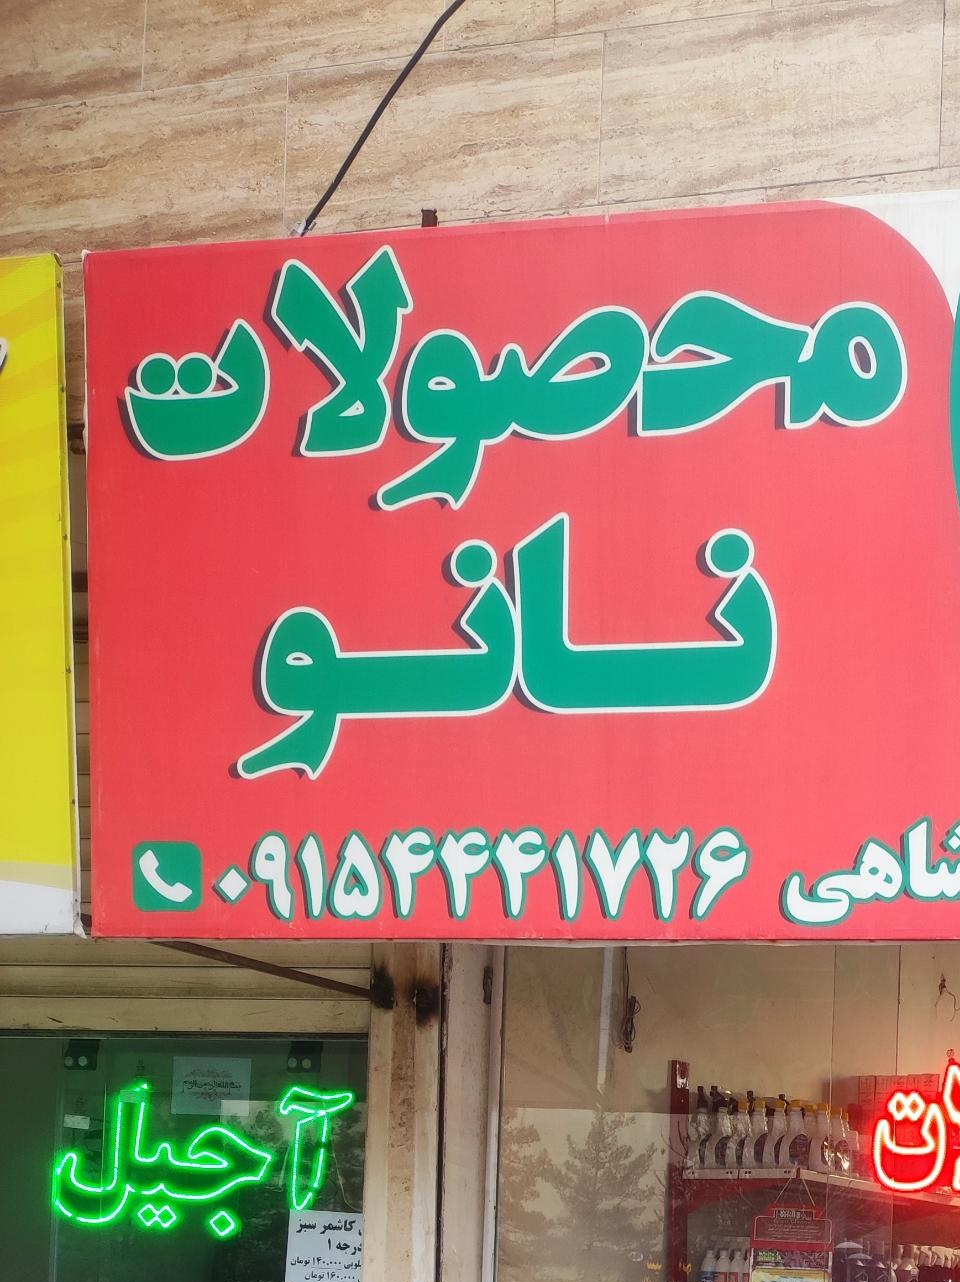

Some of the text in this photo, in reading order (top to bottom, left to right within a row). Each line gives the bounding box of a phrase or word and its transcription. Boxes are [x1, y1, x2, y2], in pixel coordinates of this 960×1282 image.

[123, 245, 909, 510] محصولات
[237, 513, 778, 779] نانو
[214, 828, 749, 921] ۰۹۱۵۴۴۴۱۷۲۶
[52, 1083, 353, 1237] آجیل
[290, 1256, 311, 1267] تومان
[296, 1219, 356, 1235] کاشمر سبز
[304, 1271, 325, 1282] تومان
